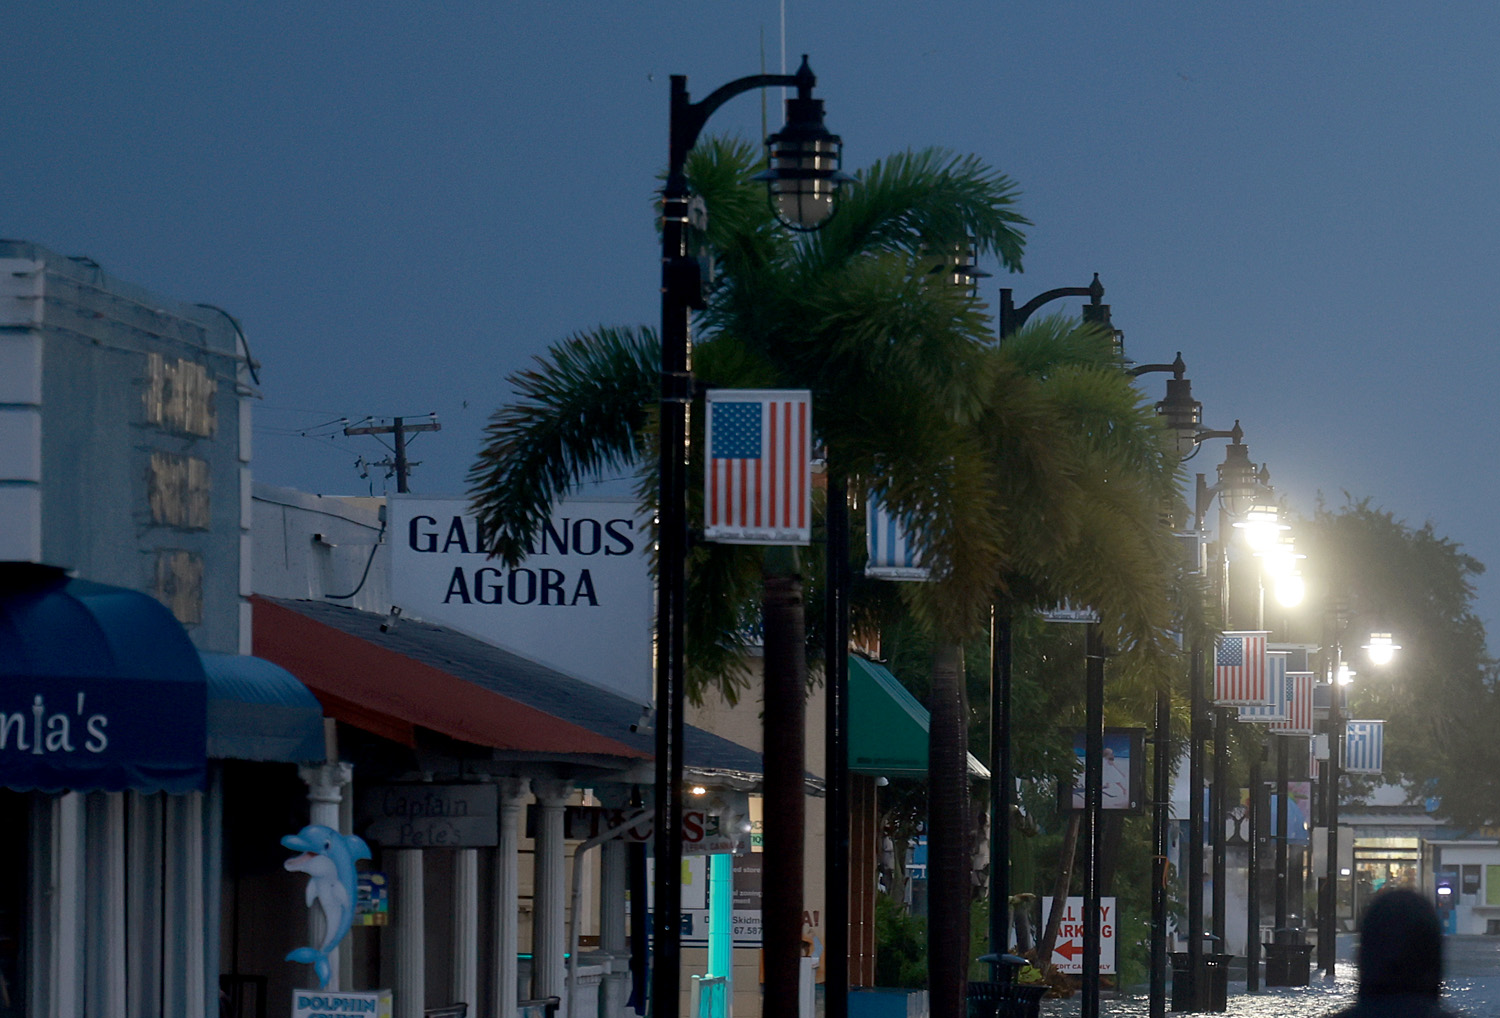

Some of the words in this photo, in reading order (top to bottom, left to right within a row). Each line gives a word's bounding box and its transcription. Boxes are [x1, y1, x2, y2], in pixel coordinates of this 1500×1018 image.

[409, 516, 634, 556] GALNOS
[441, 567, 600, 606] AGORA
[382, 788, 469, 820] Captain
[400, 823, 461, 846] Pete's
[733, 916, 760, 924] Skidm
[297, 996, 375, 1013] DOLPHIN
